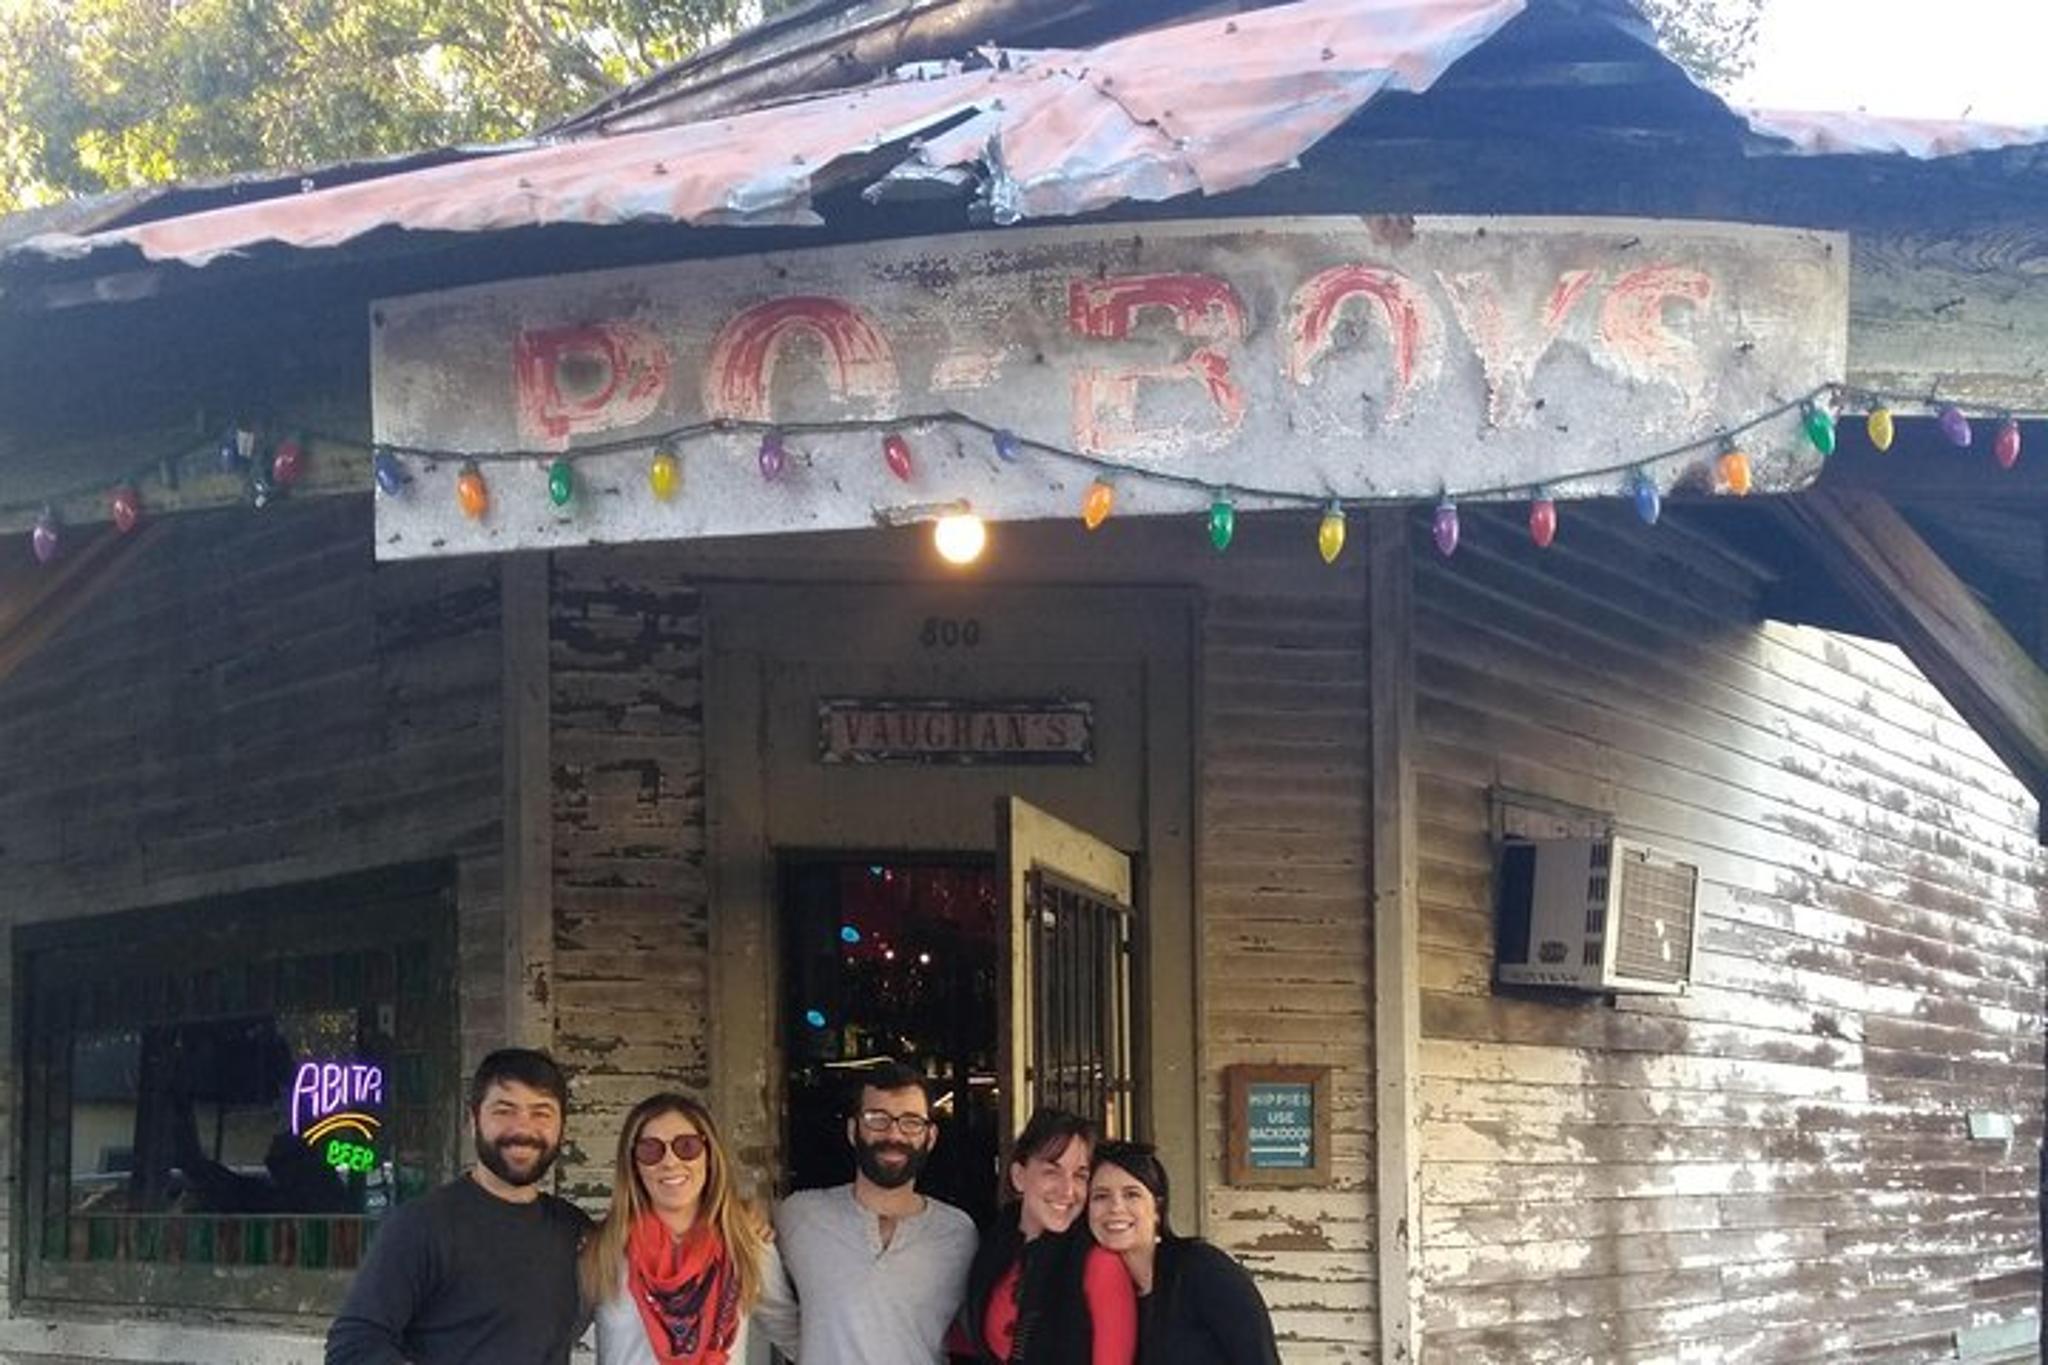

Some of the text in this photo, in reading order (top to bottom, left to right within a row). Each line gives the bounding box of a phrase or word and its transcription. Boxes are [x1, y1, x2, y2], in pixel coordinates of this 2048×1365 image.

[845, 714, 1067, 748] VAUGHAN'S
[291, 1062, 383, 1136] ABITA
[1268, 1111, 1295, 1124] USE
[327, 1140, 374, 1173] BEER
